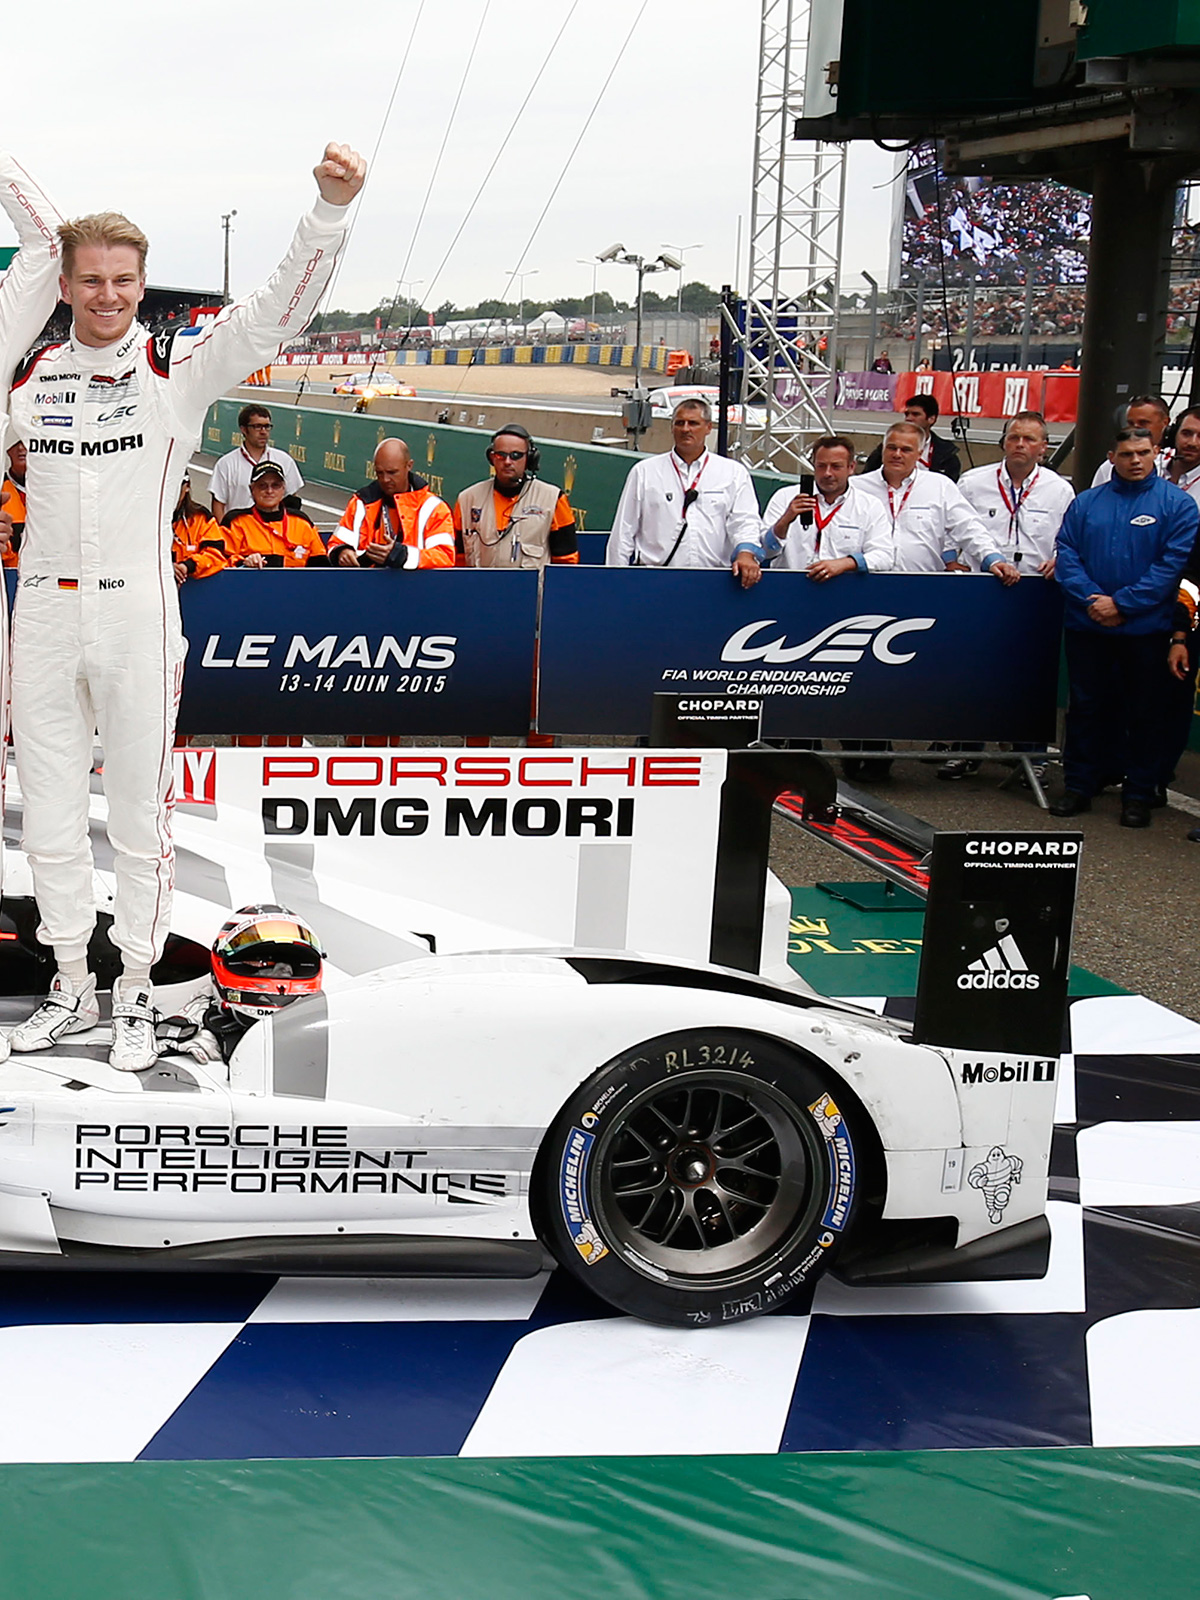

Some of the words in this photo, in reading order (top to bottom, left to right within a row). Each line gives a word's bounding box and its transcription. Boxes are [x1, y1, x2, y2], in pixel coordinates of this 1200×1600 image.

[8, 182, 59, 260] PORSCHE
[278, 248, 324, 328] PORSCHE
[291, 353, 318, 365] MOTUL
[322, 353, 344, 365] MOTUL
[347, 353, 366, 365] MOTUL
[59, 373, 81, 381] MORI
[34, 392, 64, 405] Mobil
[65, 392, 76, 404] 1
[952, 376, 982, 414] RTL
[1003, 377, 1029, 416] RTL
[29, 438, 74, 455] DMG
[81, 433, 144, 456] MORI
[323, 451, 347, 472] ROLEX
[99, 577, 125, 592] Nico
[200, 633, 276, 669] LE
[283, 633, 457, 669] MANS
[720, 614, 937, 666] WEC
[278, 674, 335, 692] 13-14
[343, 674, 388, 693] JUIN
[396, 674, 447, 693] 2015
[661, 669, 688, 681] FIA
[692, 669, 749, 682] WORLD
[749, 670, 854, 684] ENDURANCE
[726, 683, 847, 696] CHAMPIONSHIP
[677, 700, 760, 712] CHOPARD
[262, 756, 703, 787] PORSCHE
[263, 797, 431, 837] DMG
[444, 797, 636, 838] MORI
[965, 840, 1078, 856] CHOPARD
[957, 968, 1040, 990] adidas
[962, 1060, 1029, 1084] Mobil
[1034, 1061, 1055, 1082] 1
[75, 1124, 349, 1147] PORSCHE
[75, 1148, 428, 1170] INTELLIGENT
[564, 1132, 586, 1223] MICHELIN
[831, 1137, 852, 1227] MICHELIN
